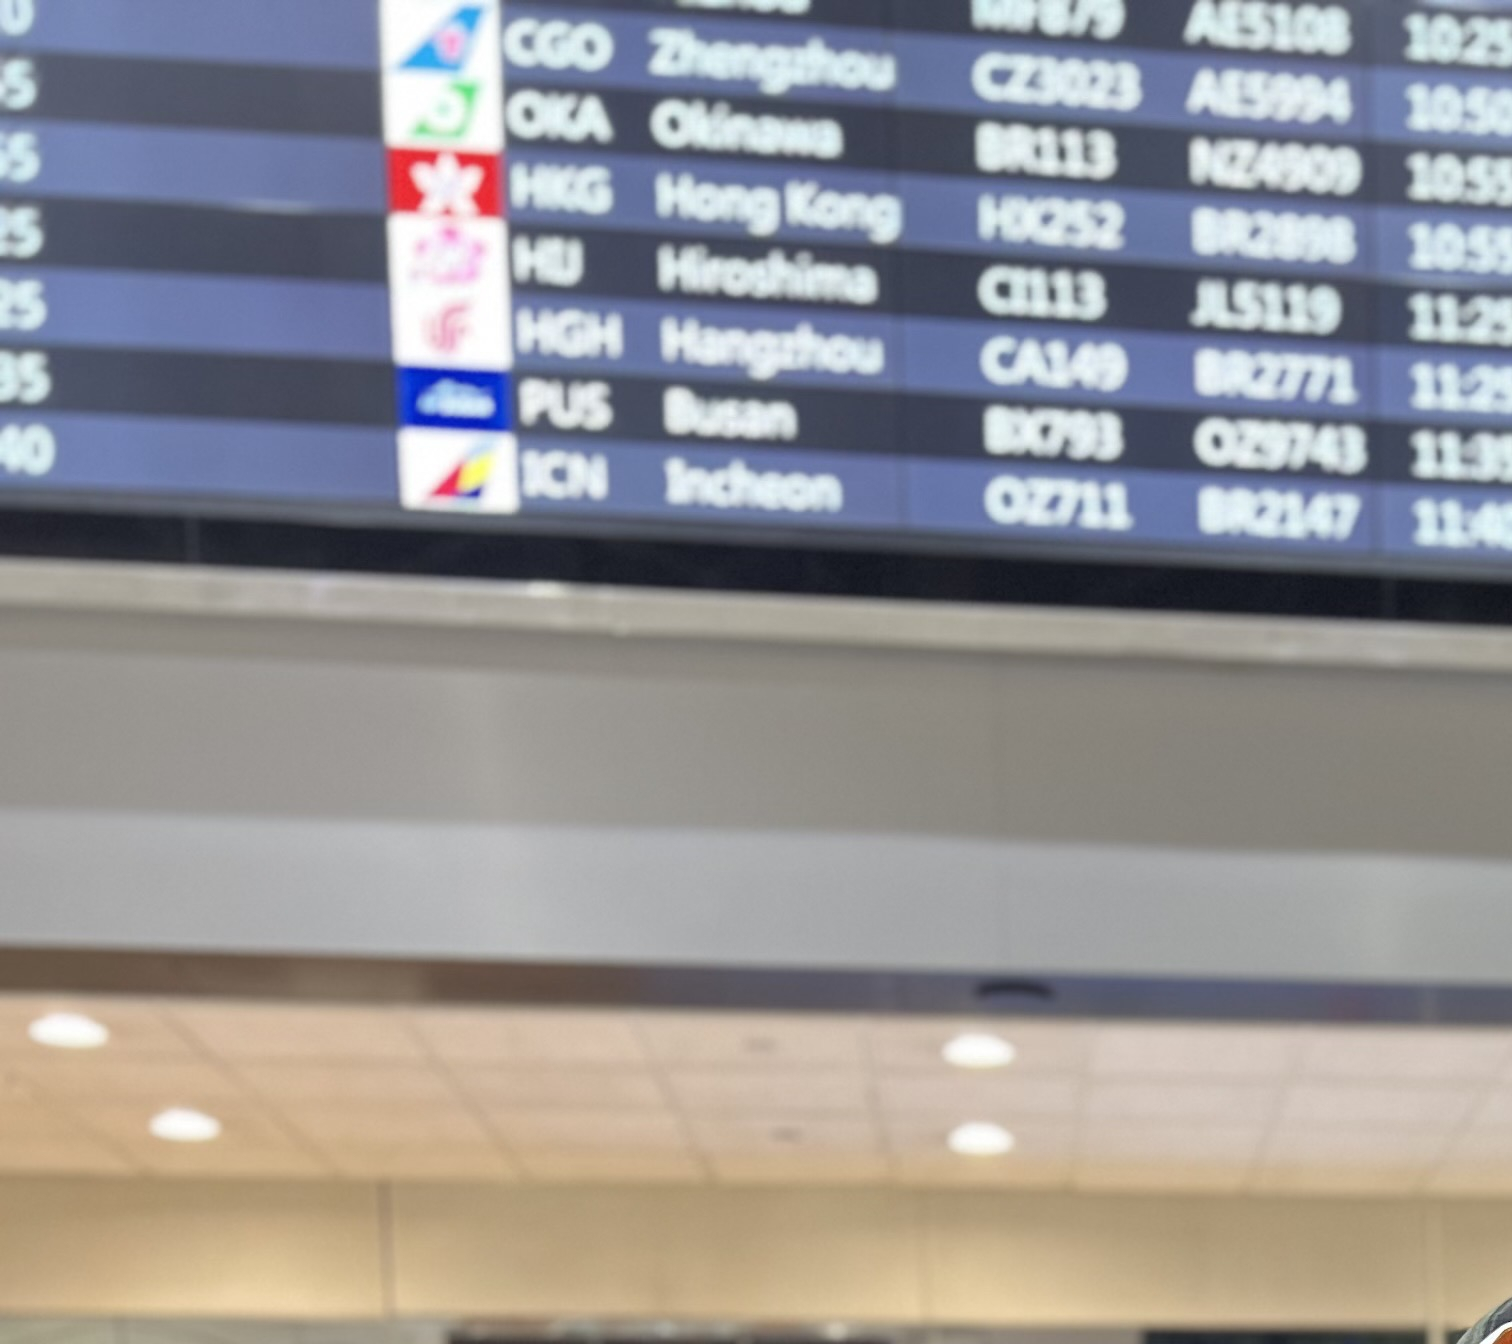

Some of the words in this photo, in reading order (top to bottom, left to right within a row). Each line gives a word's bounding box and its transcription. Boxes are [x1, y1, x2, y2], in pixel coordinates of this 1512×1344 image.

[505, 18, 614, 72] CGO
[648, 28, 897, 94] Zhengzhou
[972, 52, 1142, 111] CZ3023
[506, 90, 613, 144] OKA
[650, 100, 843, 158] Okinawa
[975, 123, 1117, 179] BR113
[511, 163, 613, 215] HKG
[656, 173, 780, 235] Hong
[785, 181, 901, 244] Kong
[658, 246, 878, 304] Hiroshima
[517, 311, 624, 361] HGH
[660, 318, 884, 381] Hangzhou
[980, 336, 1129, 392] CA149
[519, 379, 613, 430] PUS
[663, 386, 798, 439] Busan
[521, 452, 608, 503] ICN
[664, 457, 843, 513] Incheon
[984, 475, 1133, 531] OZ711
